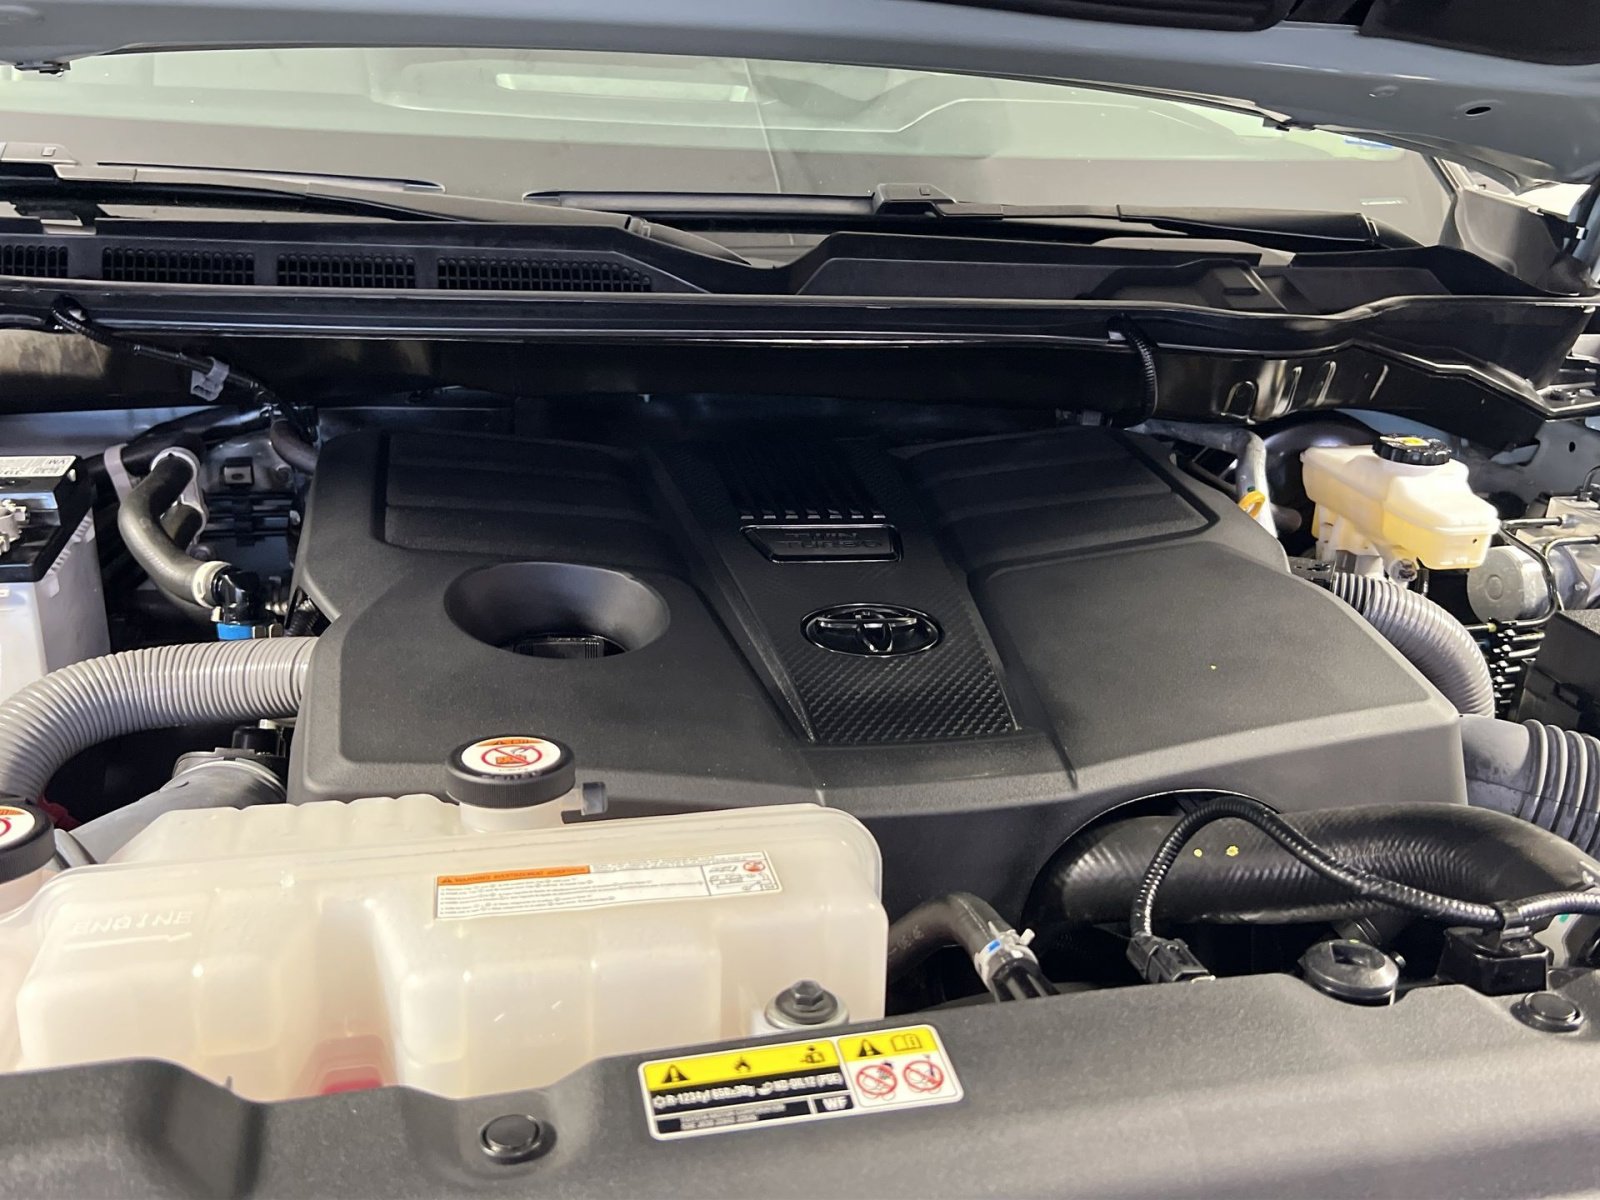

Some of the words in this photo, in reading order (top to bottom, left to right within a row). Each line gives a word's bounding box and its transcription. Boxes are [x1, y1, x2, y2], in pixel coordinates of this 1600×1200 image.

[776, 540, 882, 549] TURBO
[72, 910, 193, 935] ENGINE
[822, 1096, 848, 1111] WF
